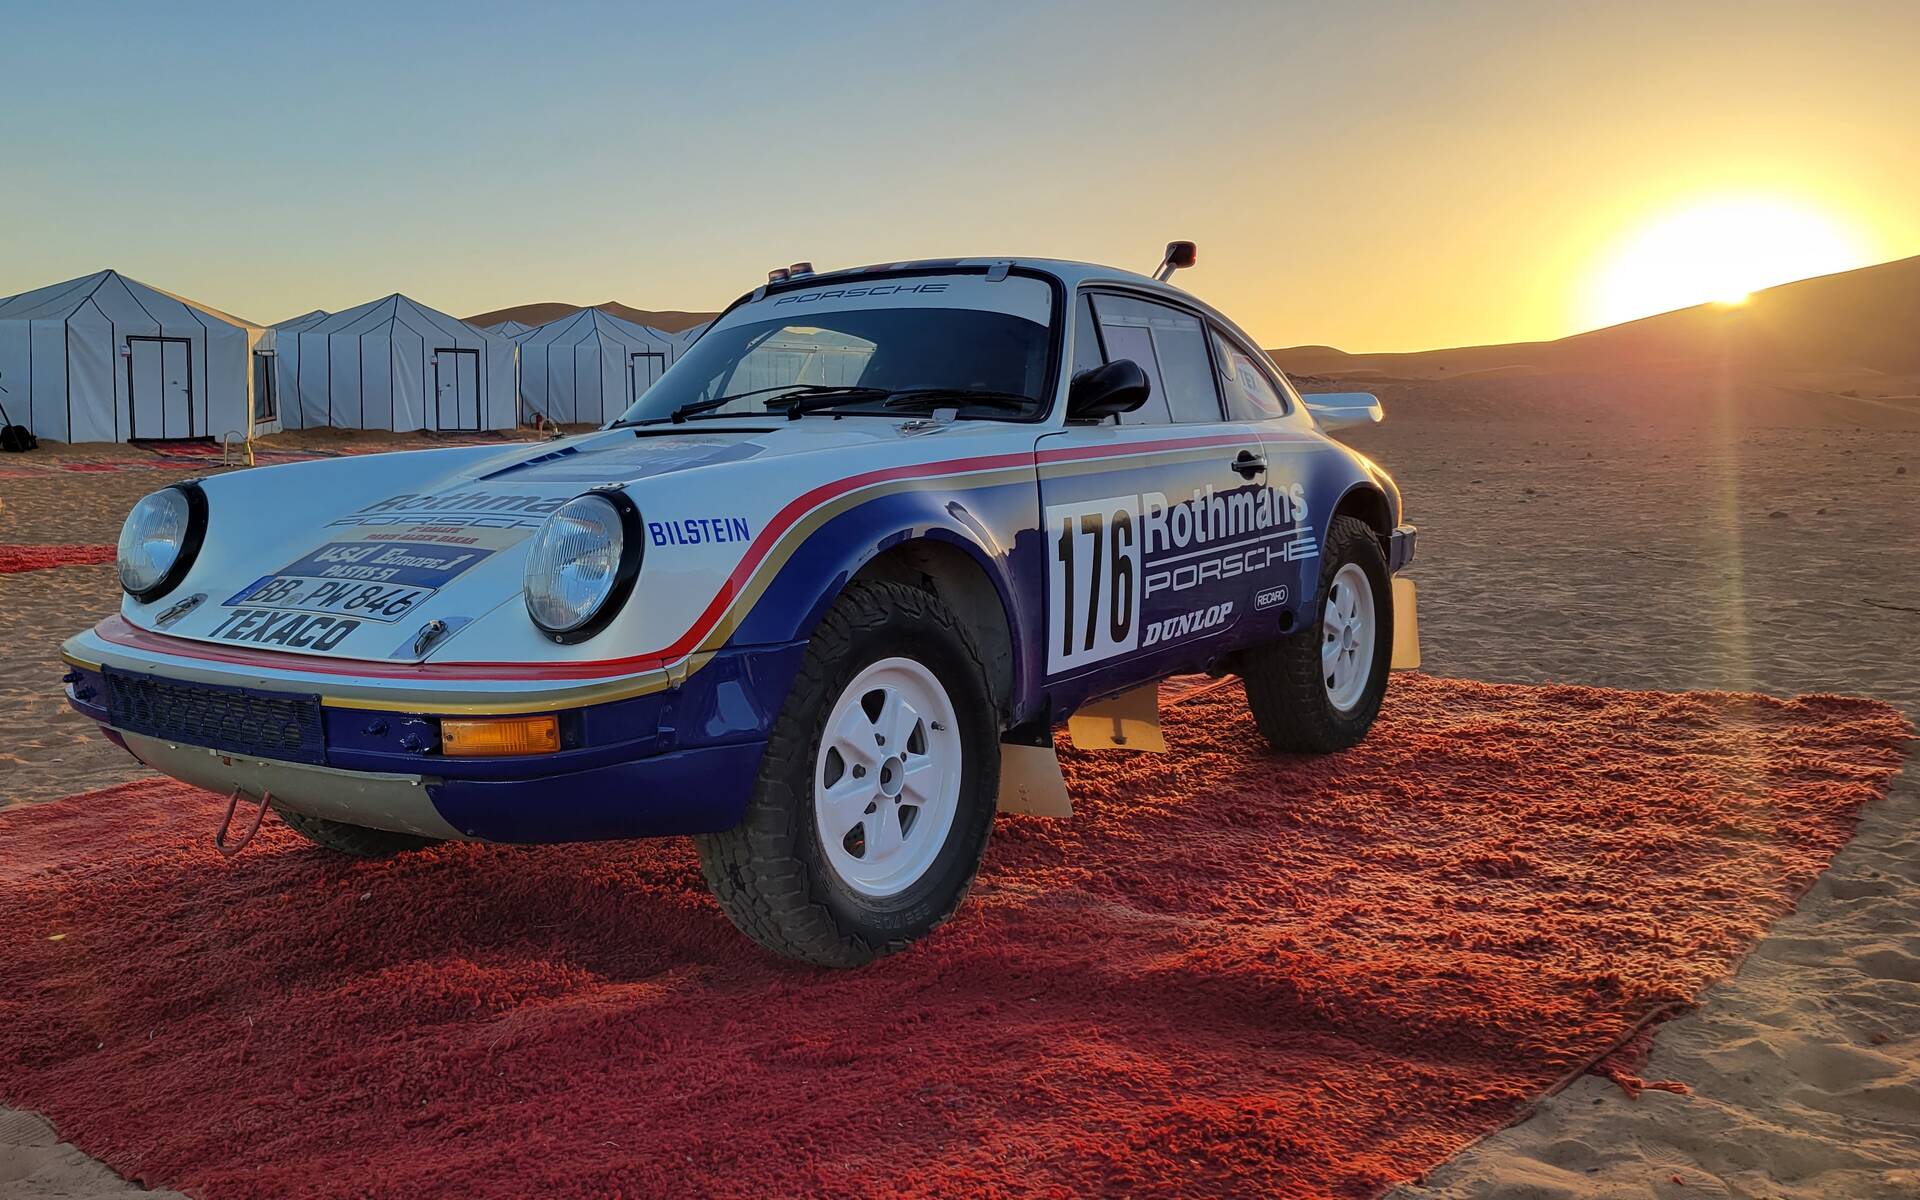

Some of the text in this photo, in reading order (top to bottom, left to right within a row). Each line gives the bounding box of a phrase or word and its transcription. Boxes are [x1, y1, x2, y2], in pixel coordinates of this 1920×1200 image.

[774, 283, 949, 307] PORSCHE
[648, 517, 751, 547] BILSTEIN
[1143, 482, 1309, 554] Rothmans
[319, 564, 400, 582] PASTIS 51
[1058, 508, 1134, 657] 176
[1144, 536, 1320, 600] PORSCHE
[245, 579, 421, 616] BB PW 846
[1256, 588, 1286, 607] RECARO
[207, 609, 362, 652] TEXACO
[1142, 601, 1235, 649] DUNLOP
